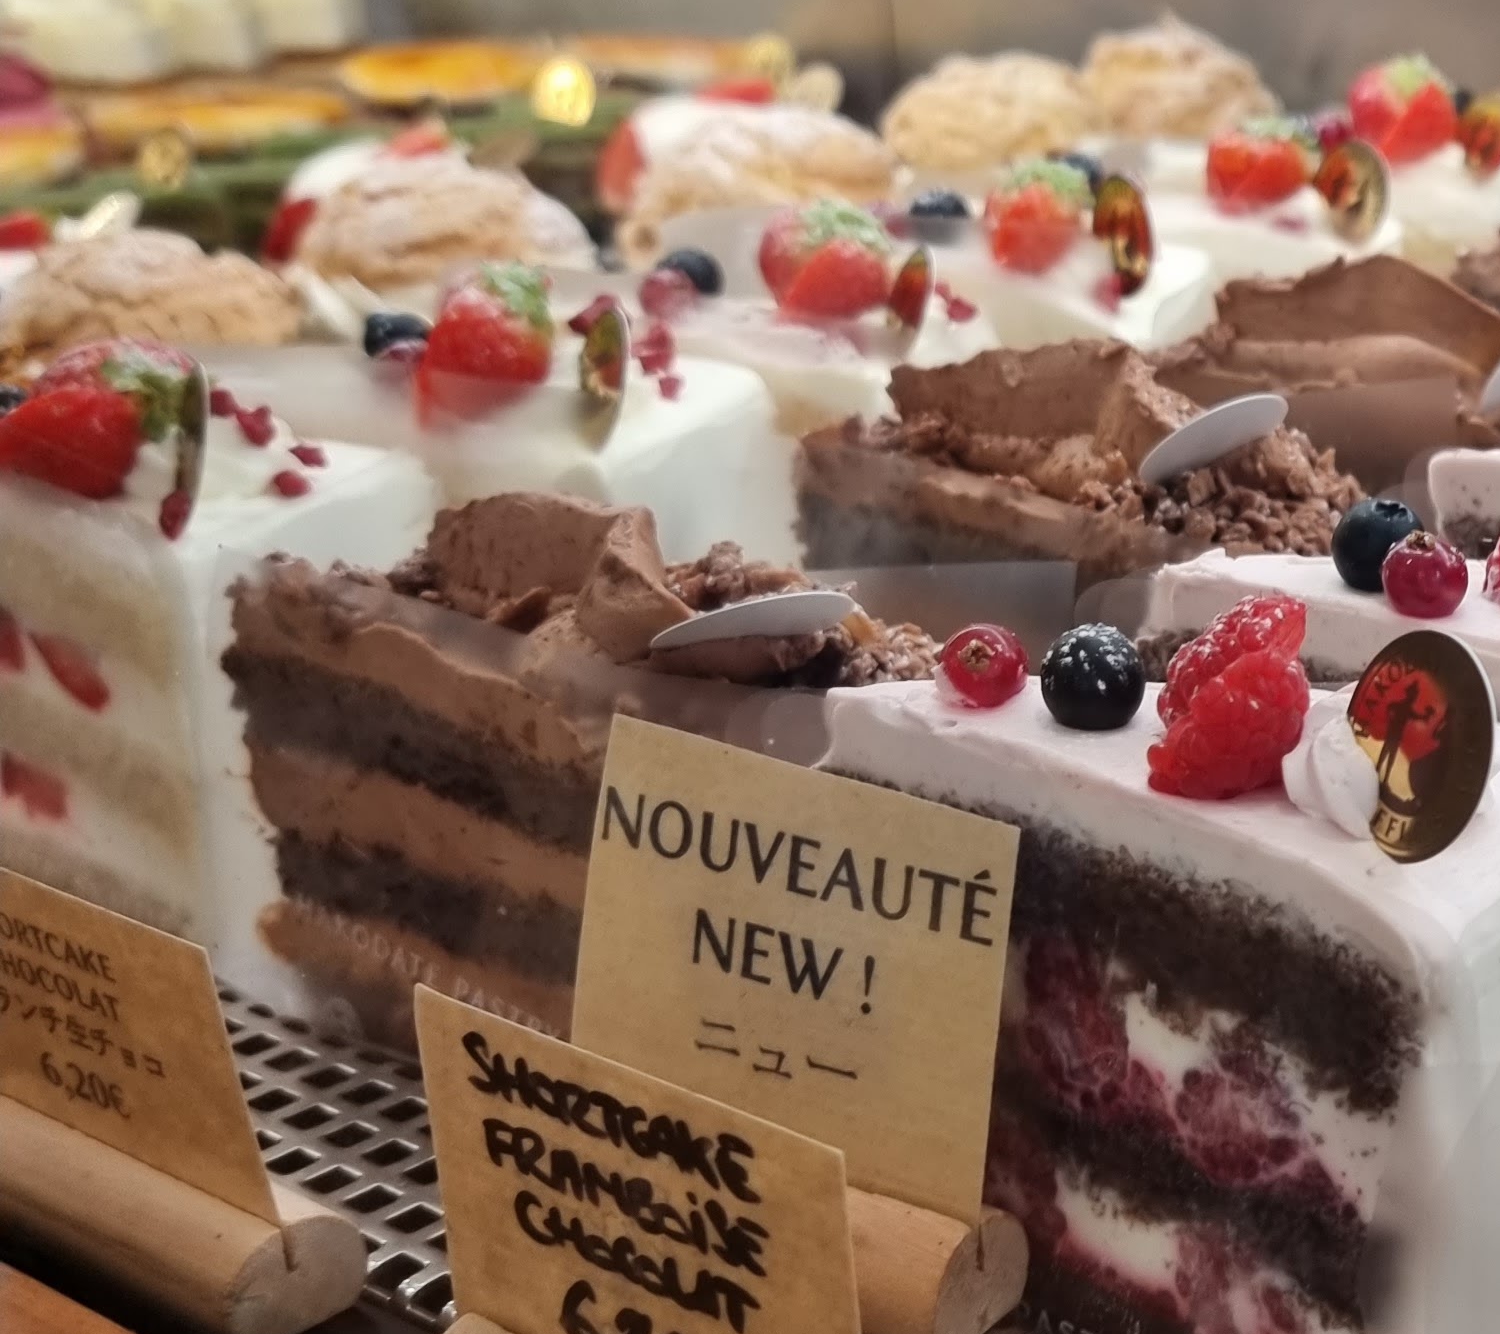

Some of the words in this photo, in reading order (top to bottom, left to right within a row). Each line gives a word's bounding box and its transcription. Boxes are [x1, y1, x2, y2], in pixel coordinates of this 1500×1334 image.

[601, 785, 998, 947] NOUVEAUTÉ
[692, 907, 844, 1001] NEW
[39, 1051, 132, 1120] 6,20€
[694, 1018, 858, 1080] ニュー
[462, 1031, 761, 1204] SHORTCAKE
